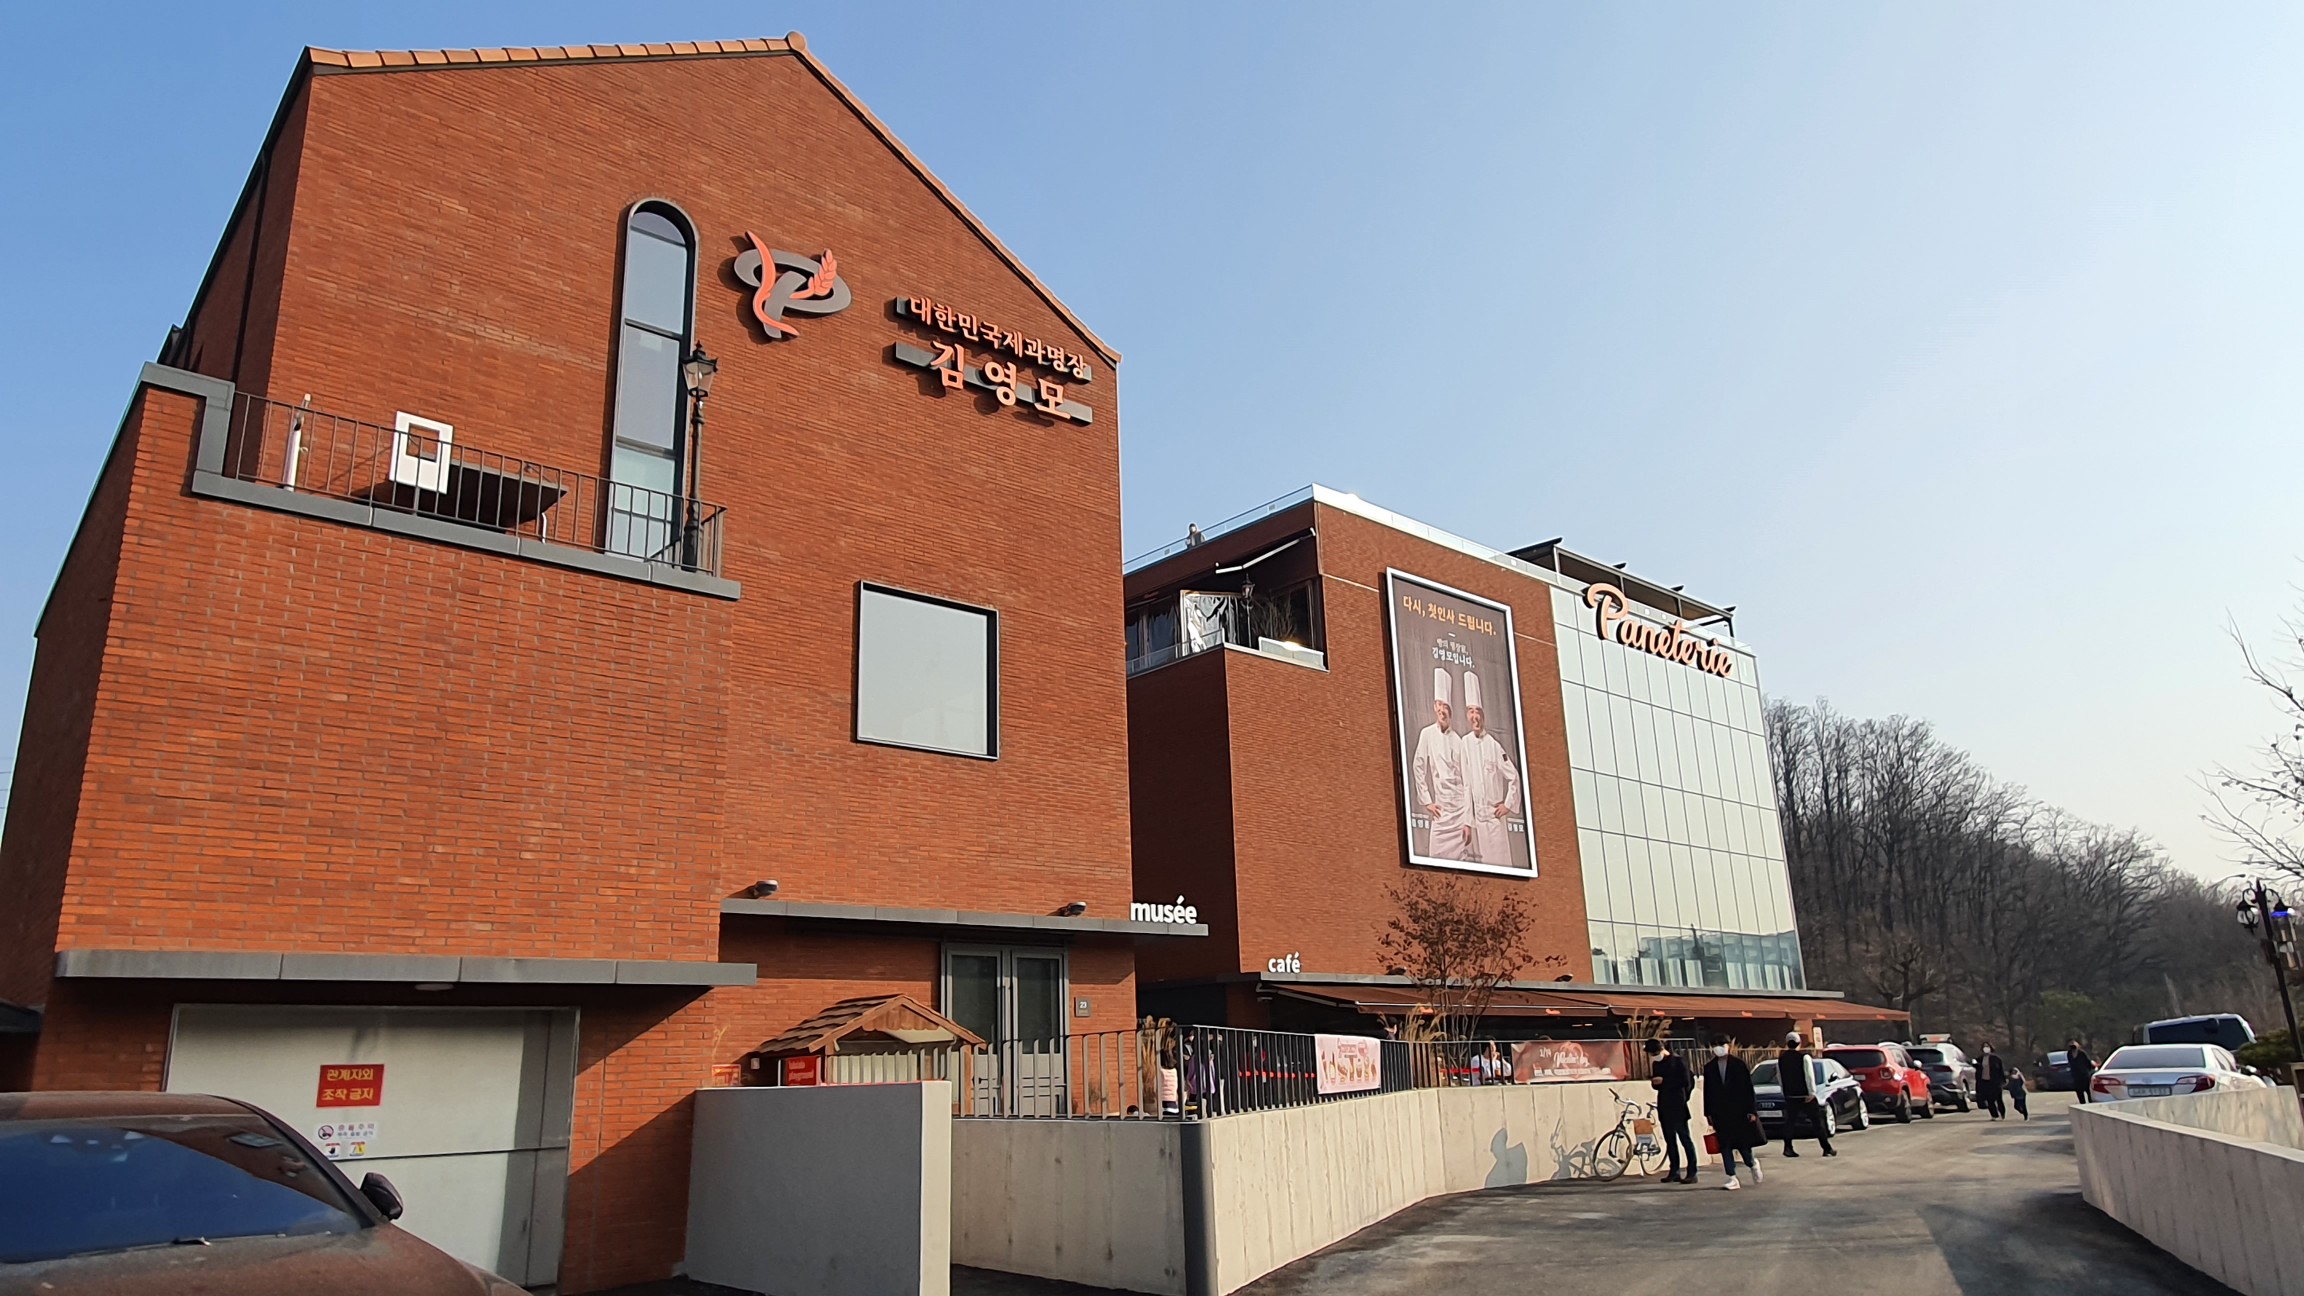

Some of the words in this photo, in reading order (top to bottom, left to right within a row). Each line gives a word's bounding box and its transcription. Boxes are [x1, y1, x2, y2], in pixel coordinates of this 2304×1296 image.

[909, 296, 1088, 379] 대한민국제과명장
[1402, 595, 1426, 618] 다시,
[1428, 603, 1455, 625] 첫인사
[1458, 613, 1497, 636] 드립니다.
[1586, 582, 1733, 678] Paneterie
[1129, 894, 1198, 925] musée
[1267, 951, 1301, 974] café
[326, 1067, 375, 1082] 관계자외
[321, 1088, 347, 1101] 조작
[349, 1087, 375, 1101] 금지
